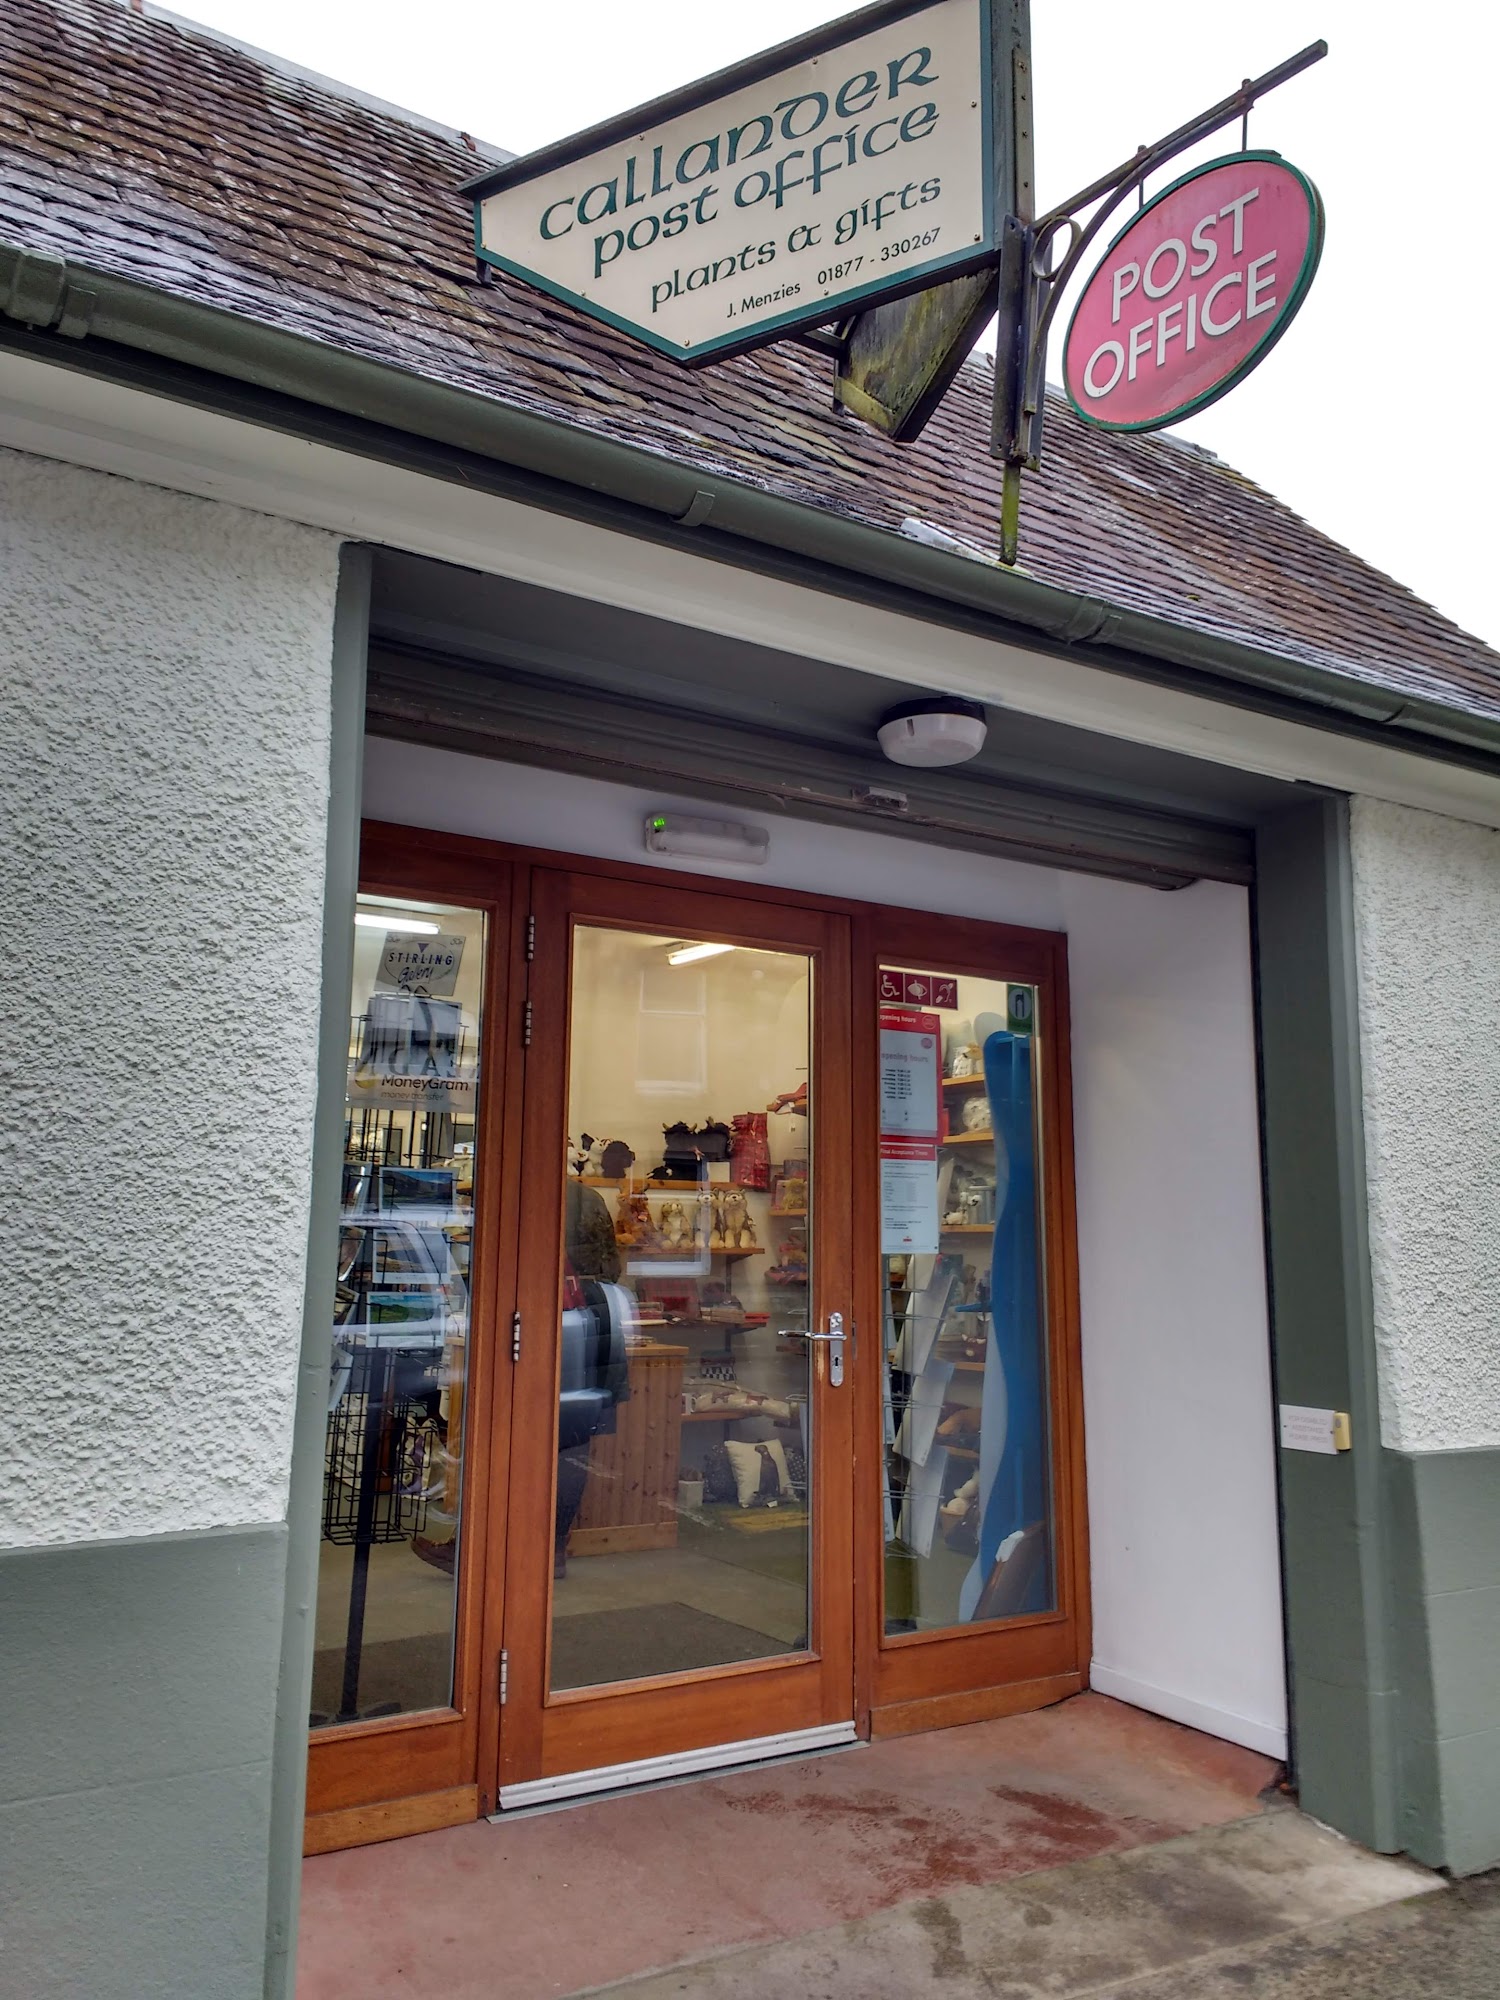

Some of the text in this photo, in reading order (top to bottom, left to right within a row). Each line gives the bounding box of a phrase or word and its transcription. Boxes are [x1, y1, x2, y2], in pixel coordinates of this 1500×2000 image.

[594, 102, 940, 279] post office
[651, 240, 776, 313] plants
[834, 177, 942, 246] gifts
[1112, 187, 1259, 324] POST
[741, 282, 801, 313] Menzies
[817, 255, 864, 285] 01877
[881, 226, 942, 262] 330267
[1082, 249, 1277, 398] OFFICE
[381, 1074, 469, 1092] MoneyGram
